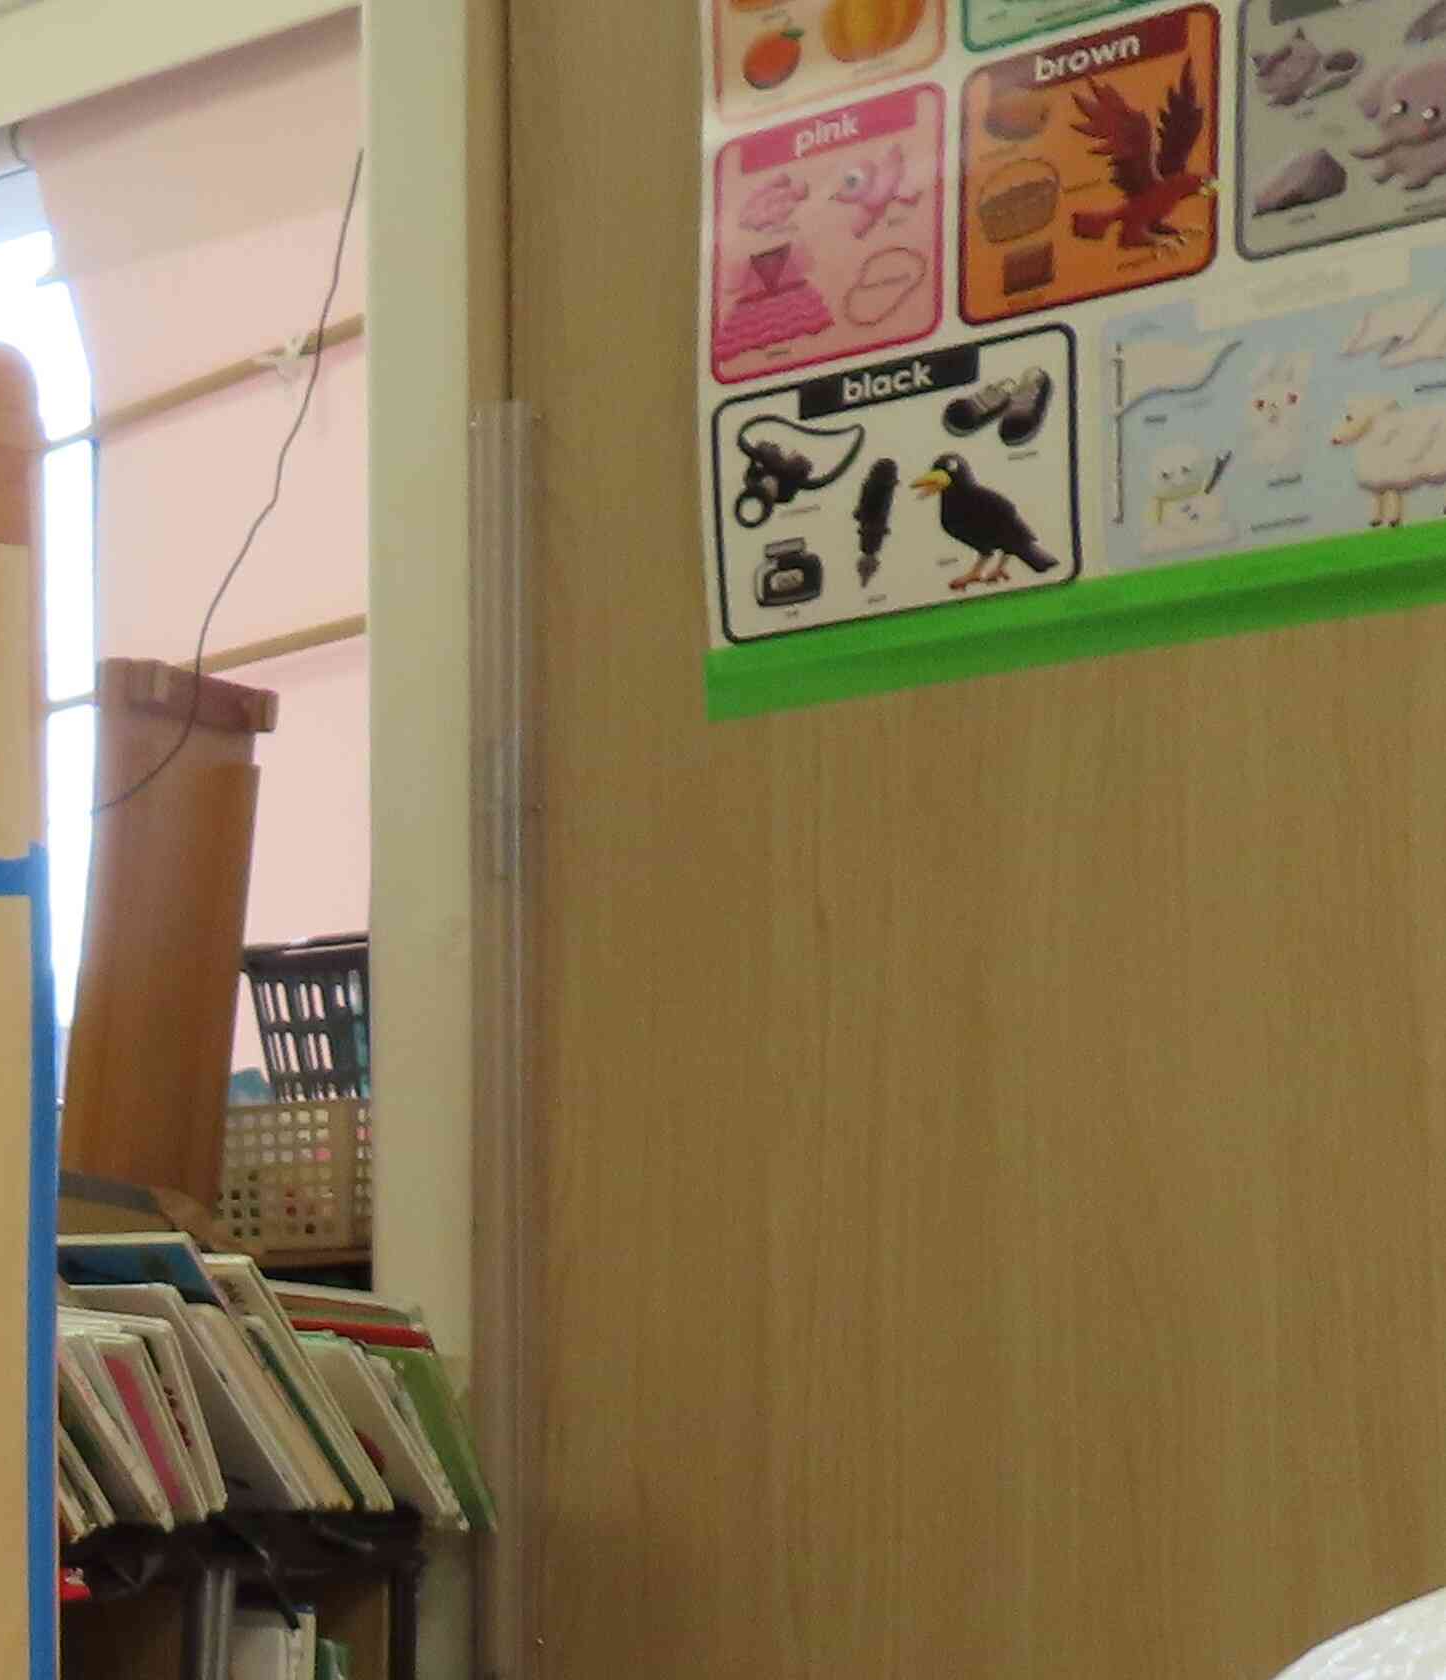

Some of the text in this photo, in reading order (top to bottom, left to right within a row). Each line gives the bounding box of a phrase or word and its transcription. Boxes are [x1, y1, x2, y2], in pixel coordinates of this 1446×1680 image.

[1033, 34, 1140, 82] brown
[794, 114, 859, 158] pink
[841, 360, 935, 402] black
